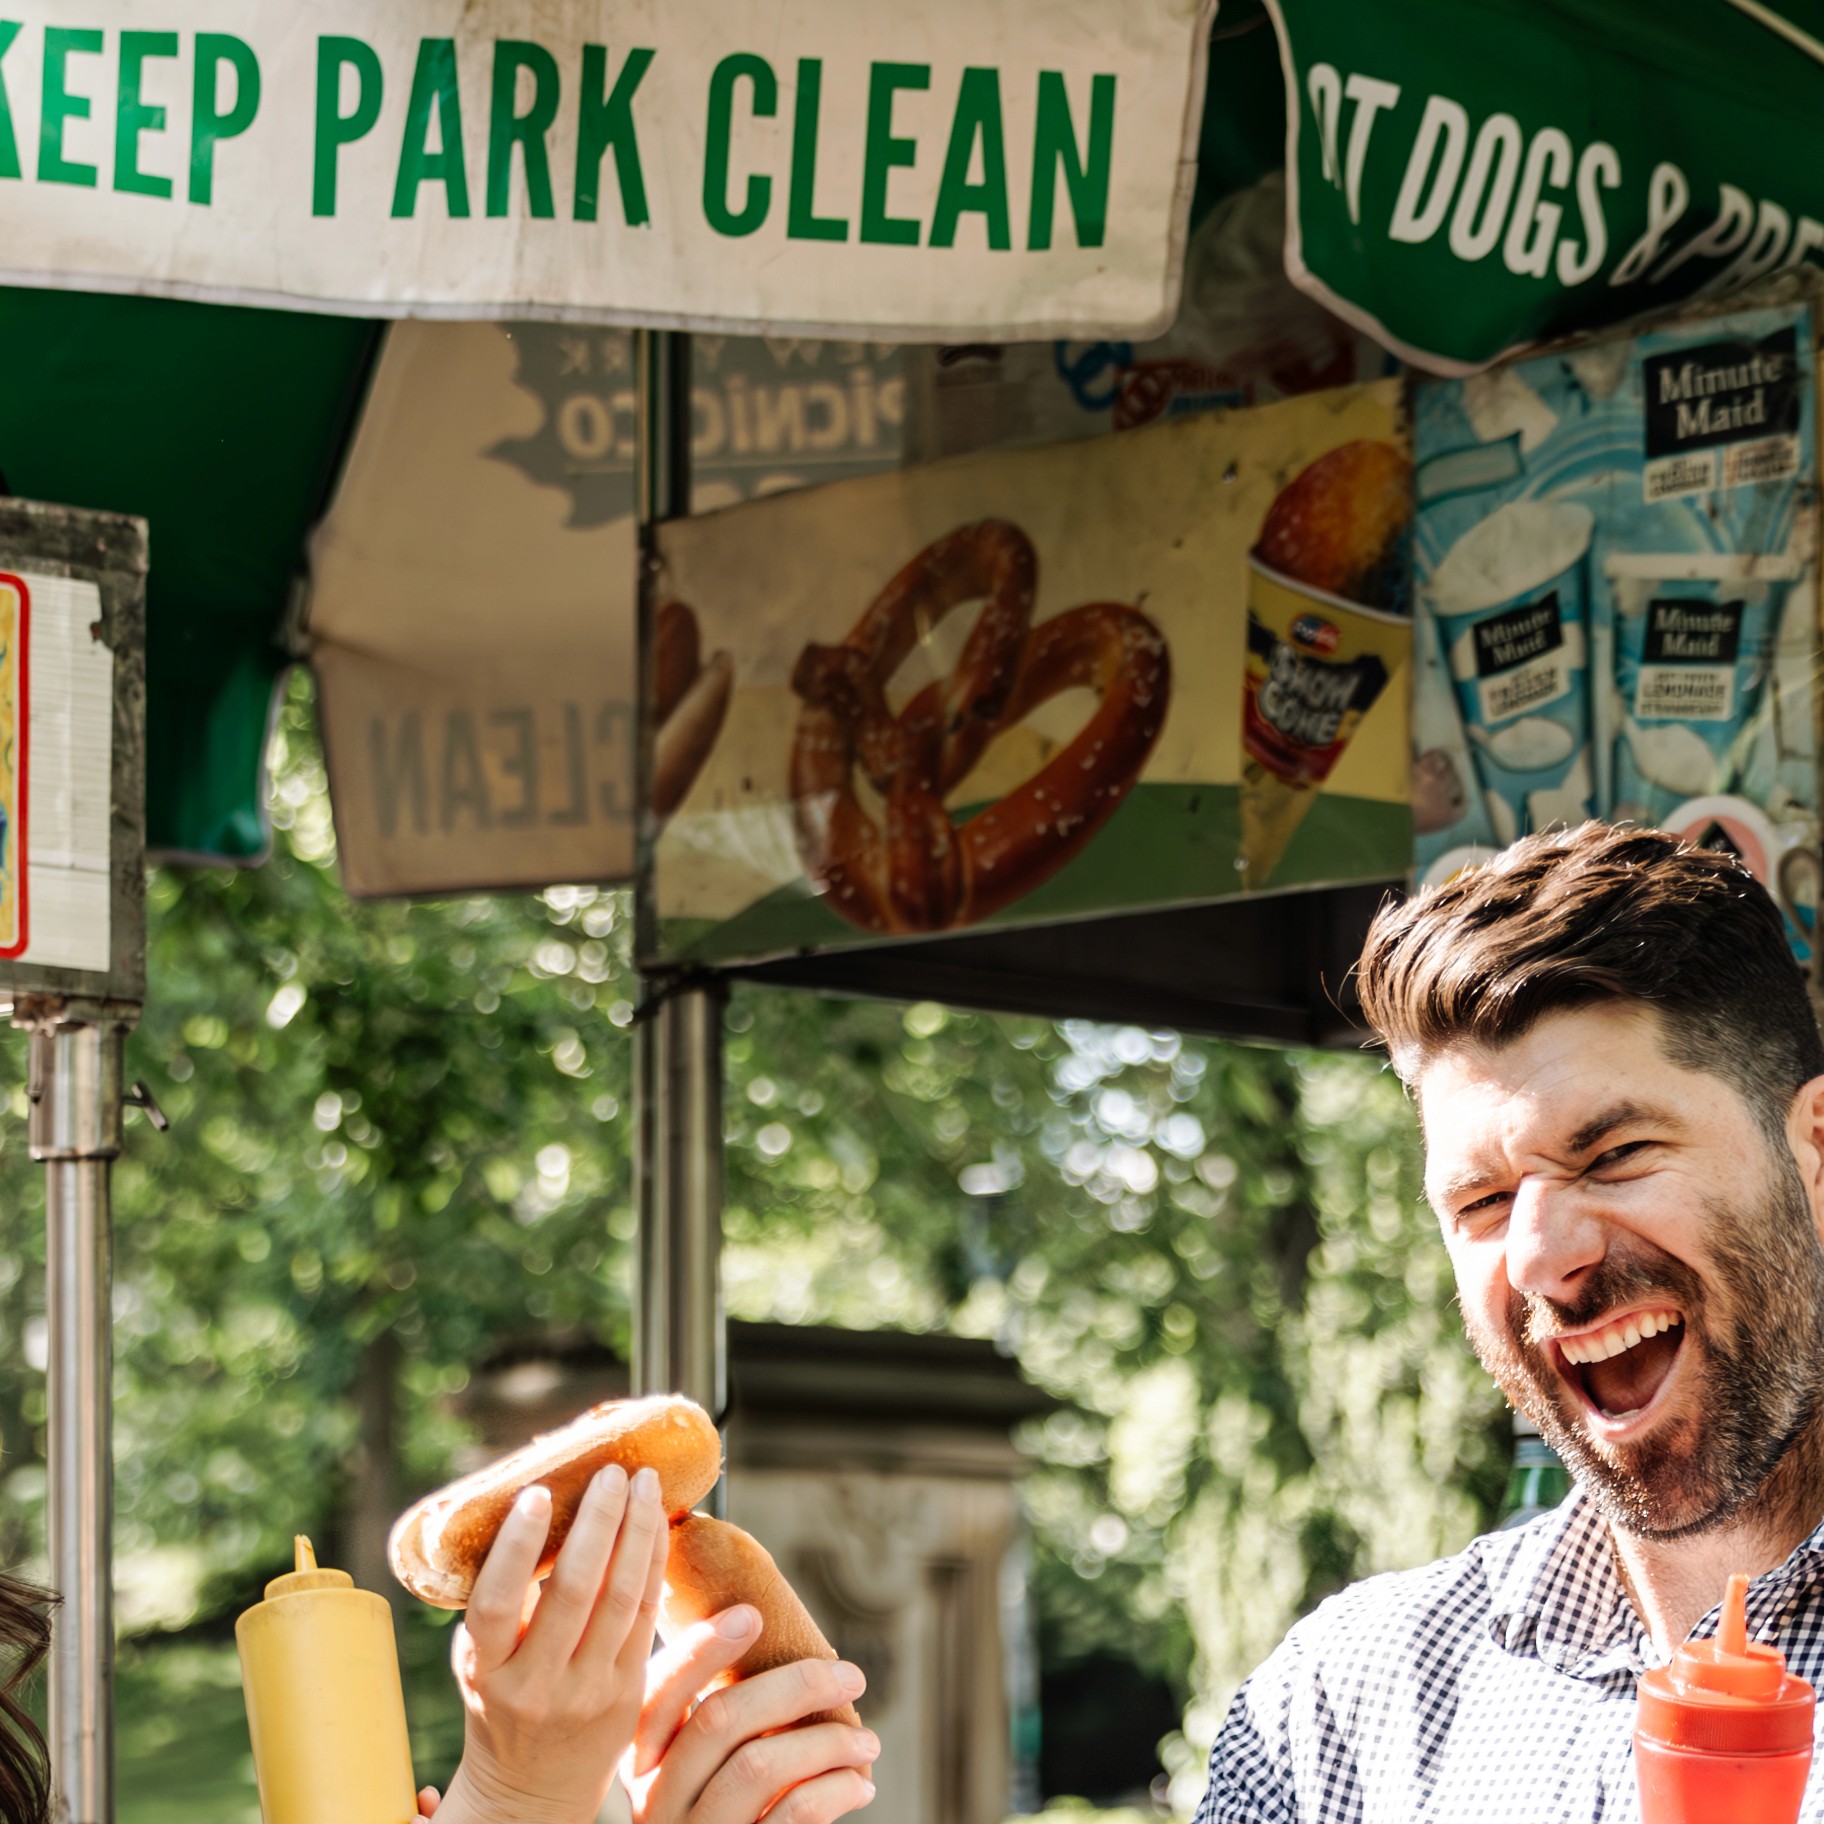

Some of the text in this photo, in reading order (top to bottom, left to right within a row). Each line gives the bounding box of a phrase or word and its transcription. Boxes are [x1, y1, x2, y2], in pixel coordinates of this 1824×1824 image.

[313, 34, 656, 226] PARK
[702, 51, 1117, 251] CLEAN
[1388, 94, 1690, 287] DOGS &
[1658, 353, 1786, 405] Minute
[1675, 390, 1768, 440] Maid
